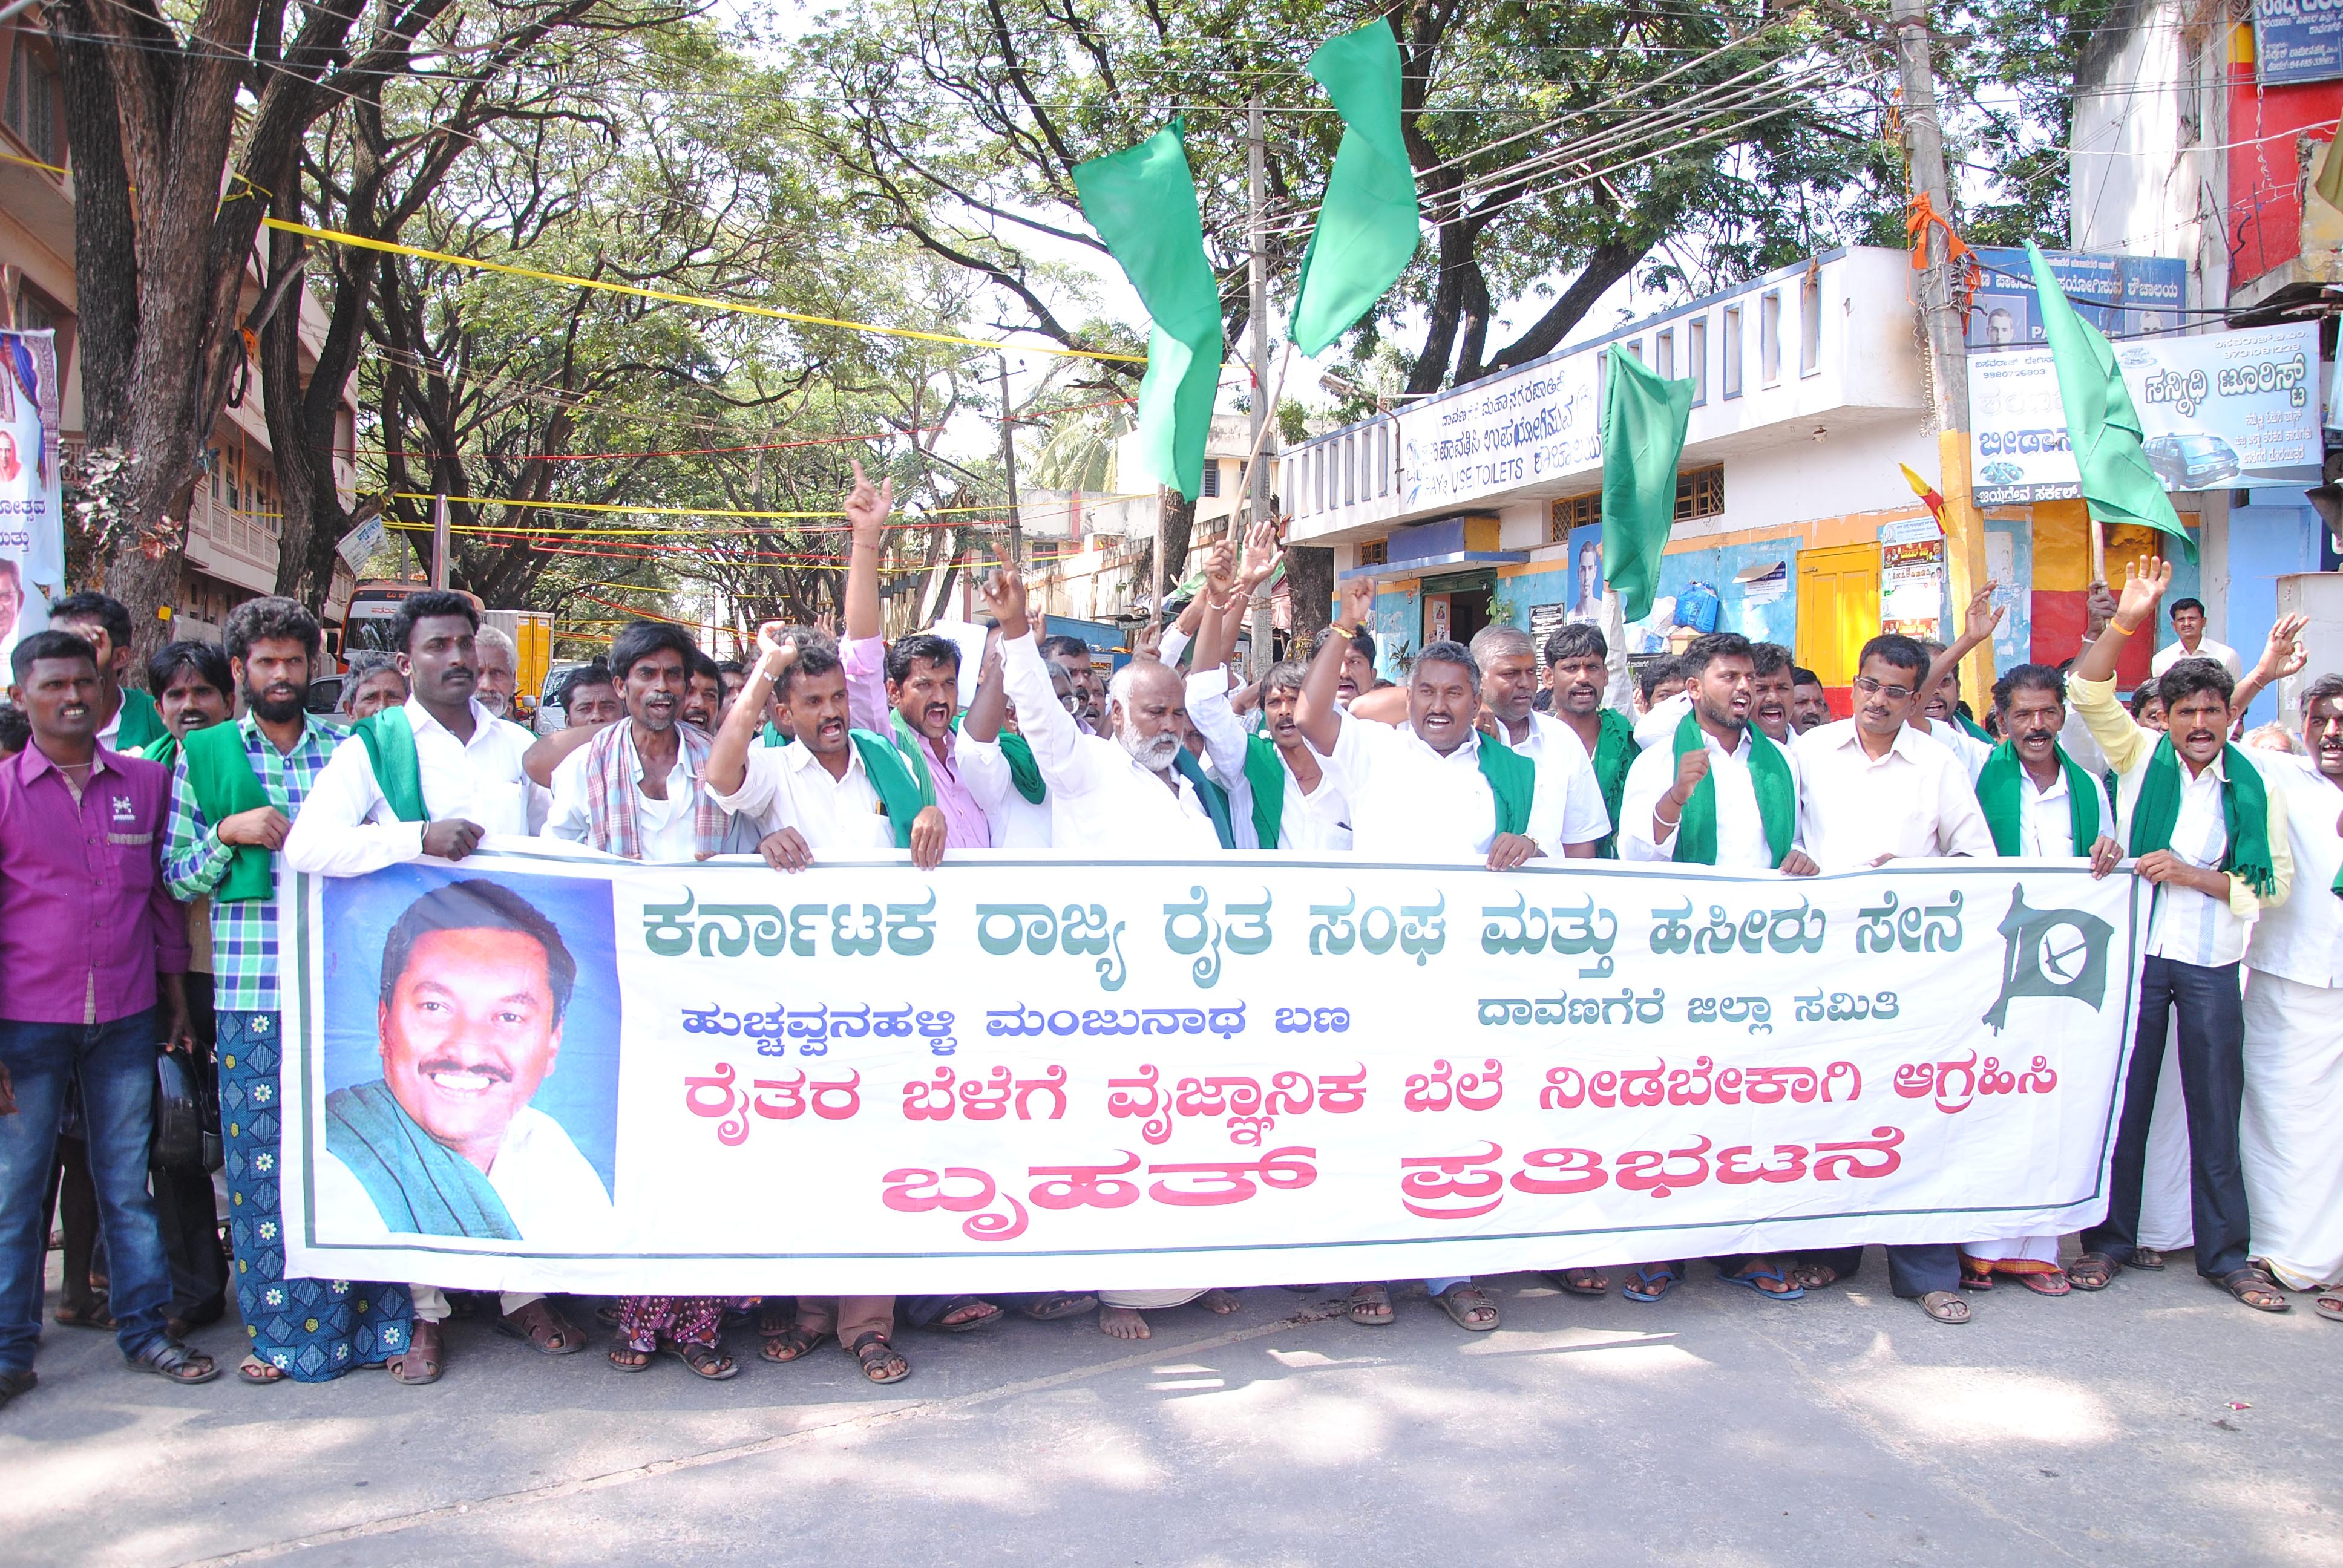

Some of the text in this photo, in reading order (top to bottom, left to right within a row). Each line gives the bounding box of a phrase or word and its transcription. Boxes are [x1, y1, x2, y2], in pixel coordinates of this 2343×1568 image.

[1983, 368, 2046, 379] 9980726803
[2145, 353, 2306, 417] ಸನ್ನಿಧಿ ಟೂರಿಸ್ಟ್
[1452, 466, 1472, 493] USE
[1476, 457, 1524, 485] TOILETS
[644, 884, 1964, 991] ಕರ್ನಾಟಕ ರಾಜ್ಯ ರೈತ ಸಂಘ ಮತ್ತು ಹಸೀರು ಸೇನೆ
[682, 1001, 1350, 1057] ಹುಚ್ಚವ್ವನಹಳ್ಳಿ ಮಂಜುನಾಥ ಬಣ
[1478, 987, 1899, 1035] ದಾವಣಗೆರೆ ಜಿಲ್ಲಾ ಸಮಿತಿ
[684, 1048, 2058, 1146] ರೈತರ ಬೆಳೆಗೆ ವೈಜ್ಞಾನಿಕ ಬೆಲೆ ನೀಡಬೇಕಾಗಿ ಆಗ್ರಹಿಸಿ
[882, 1126, 1905, 1241] ಬೃಹತ್ ಪ್ರತಿಭಟನೆ
